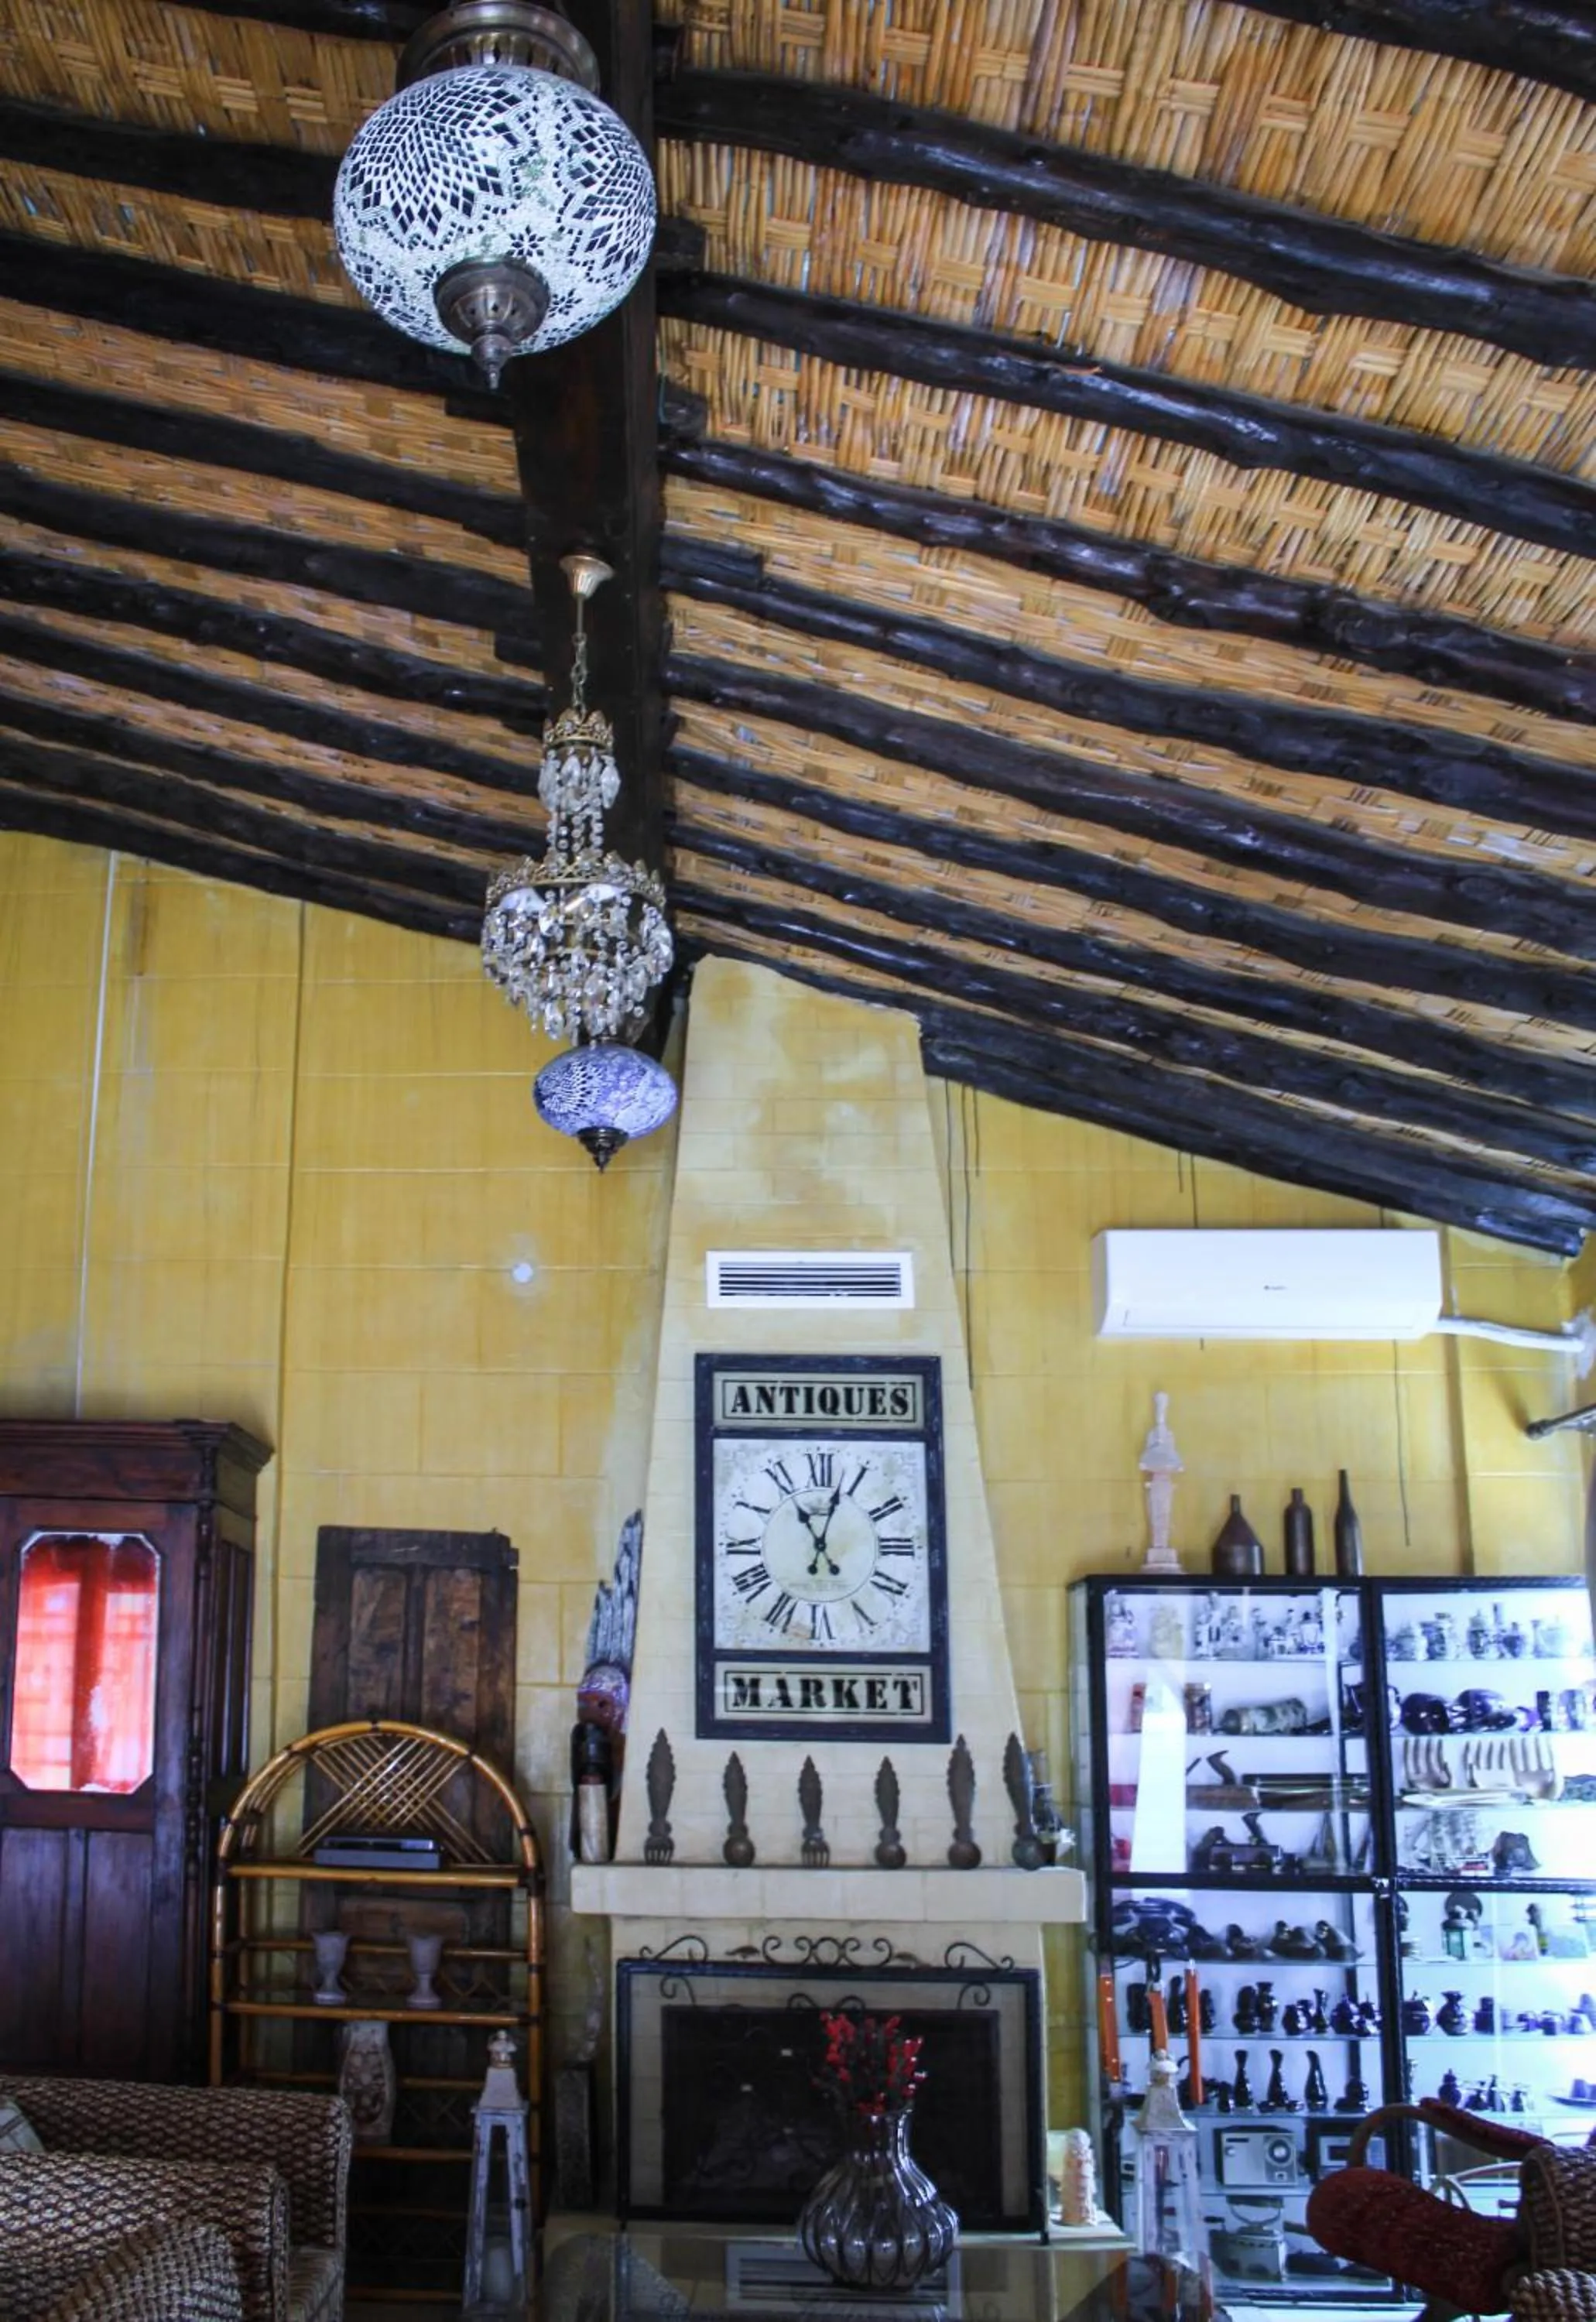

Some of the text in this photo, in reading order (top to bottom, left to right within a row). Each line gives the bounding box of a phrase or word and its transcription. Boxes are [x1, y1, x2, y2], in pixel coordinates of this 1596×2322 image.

[731, 1385, 909, 1416] ANTIQUES
[878, 1536, 915, 1559] III
[732, 1677, 918, 1710] MARKET
